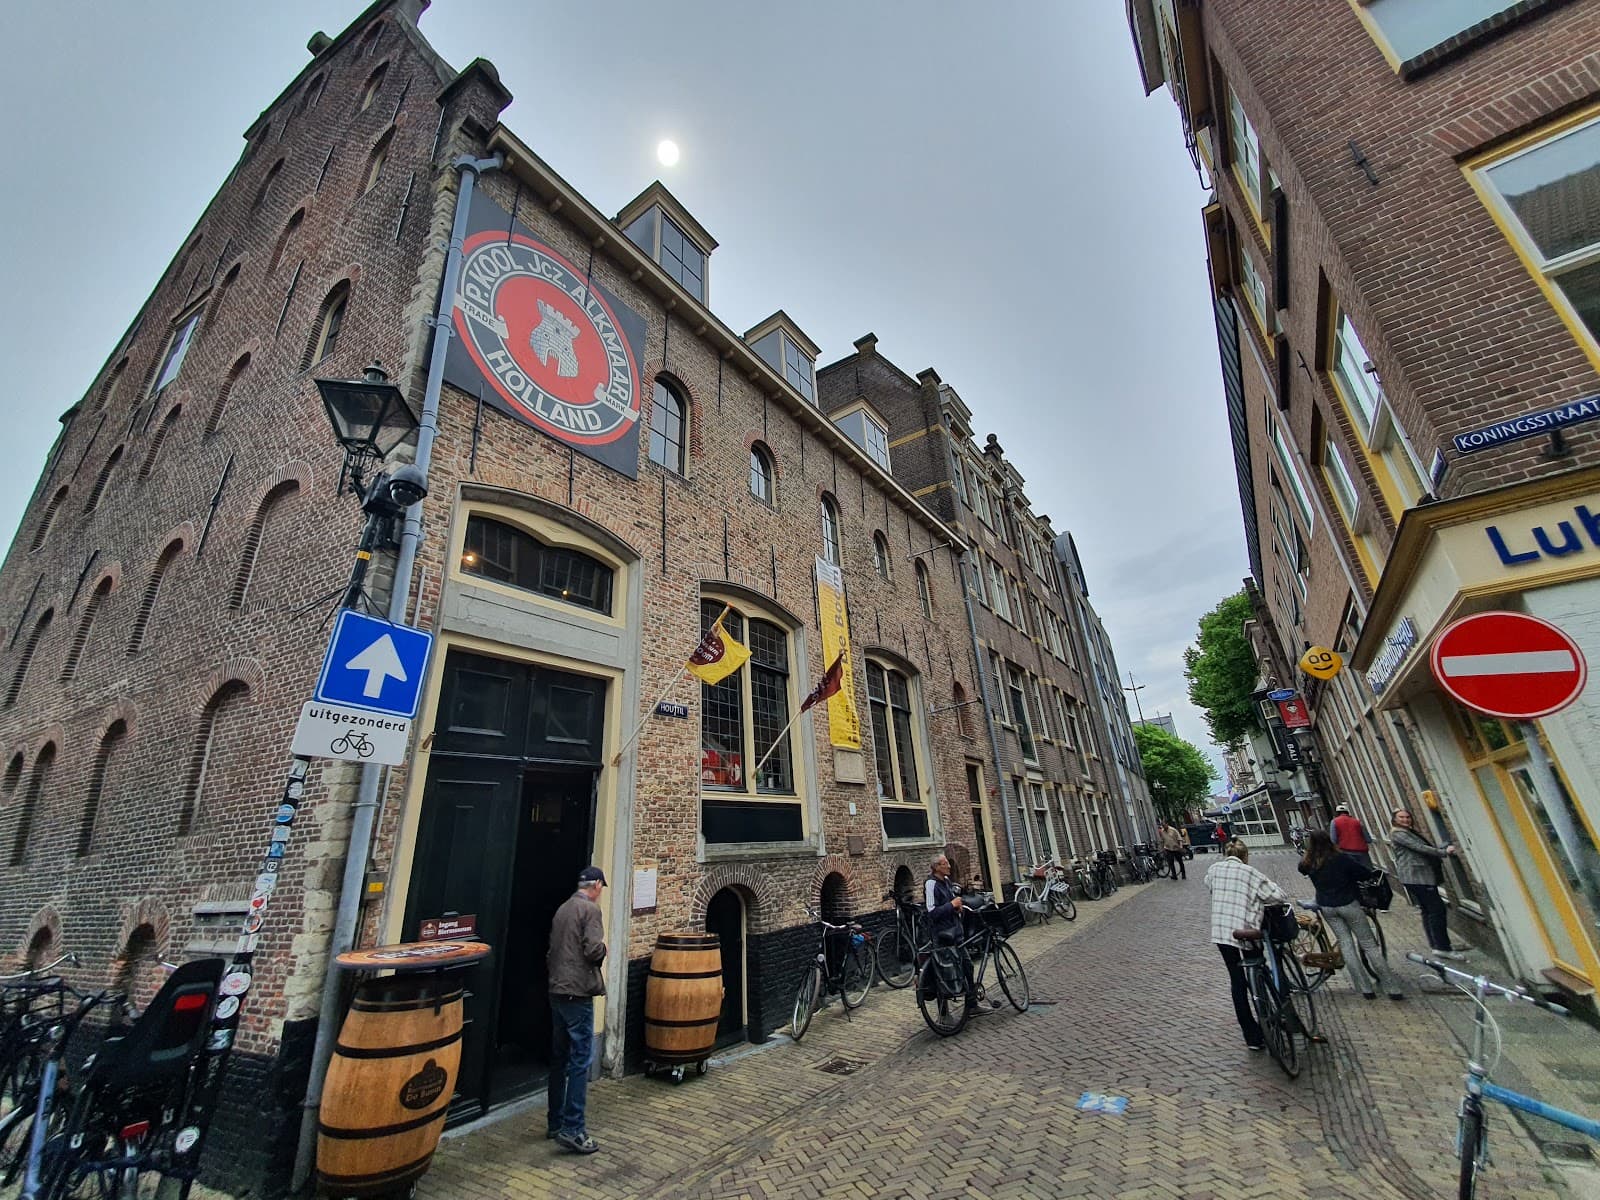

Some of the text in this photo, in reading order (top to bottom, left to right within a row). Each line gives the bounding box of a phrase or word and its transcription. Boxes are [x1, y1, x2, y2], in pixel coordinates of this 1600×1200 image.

[463, 301, 496, 328] TRADE
[571, 285, 629, 402] ALKMAAR
[486, 350, 602, 432] HOLLAND
[1458, 399, 1600, 450] KONINGSSTRAAT
[309, 708, 406, 732] uitgezonderd
